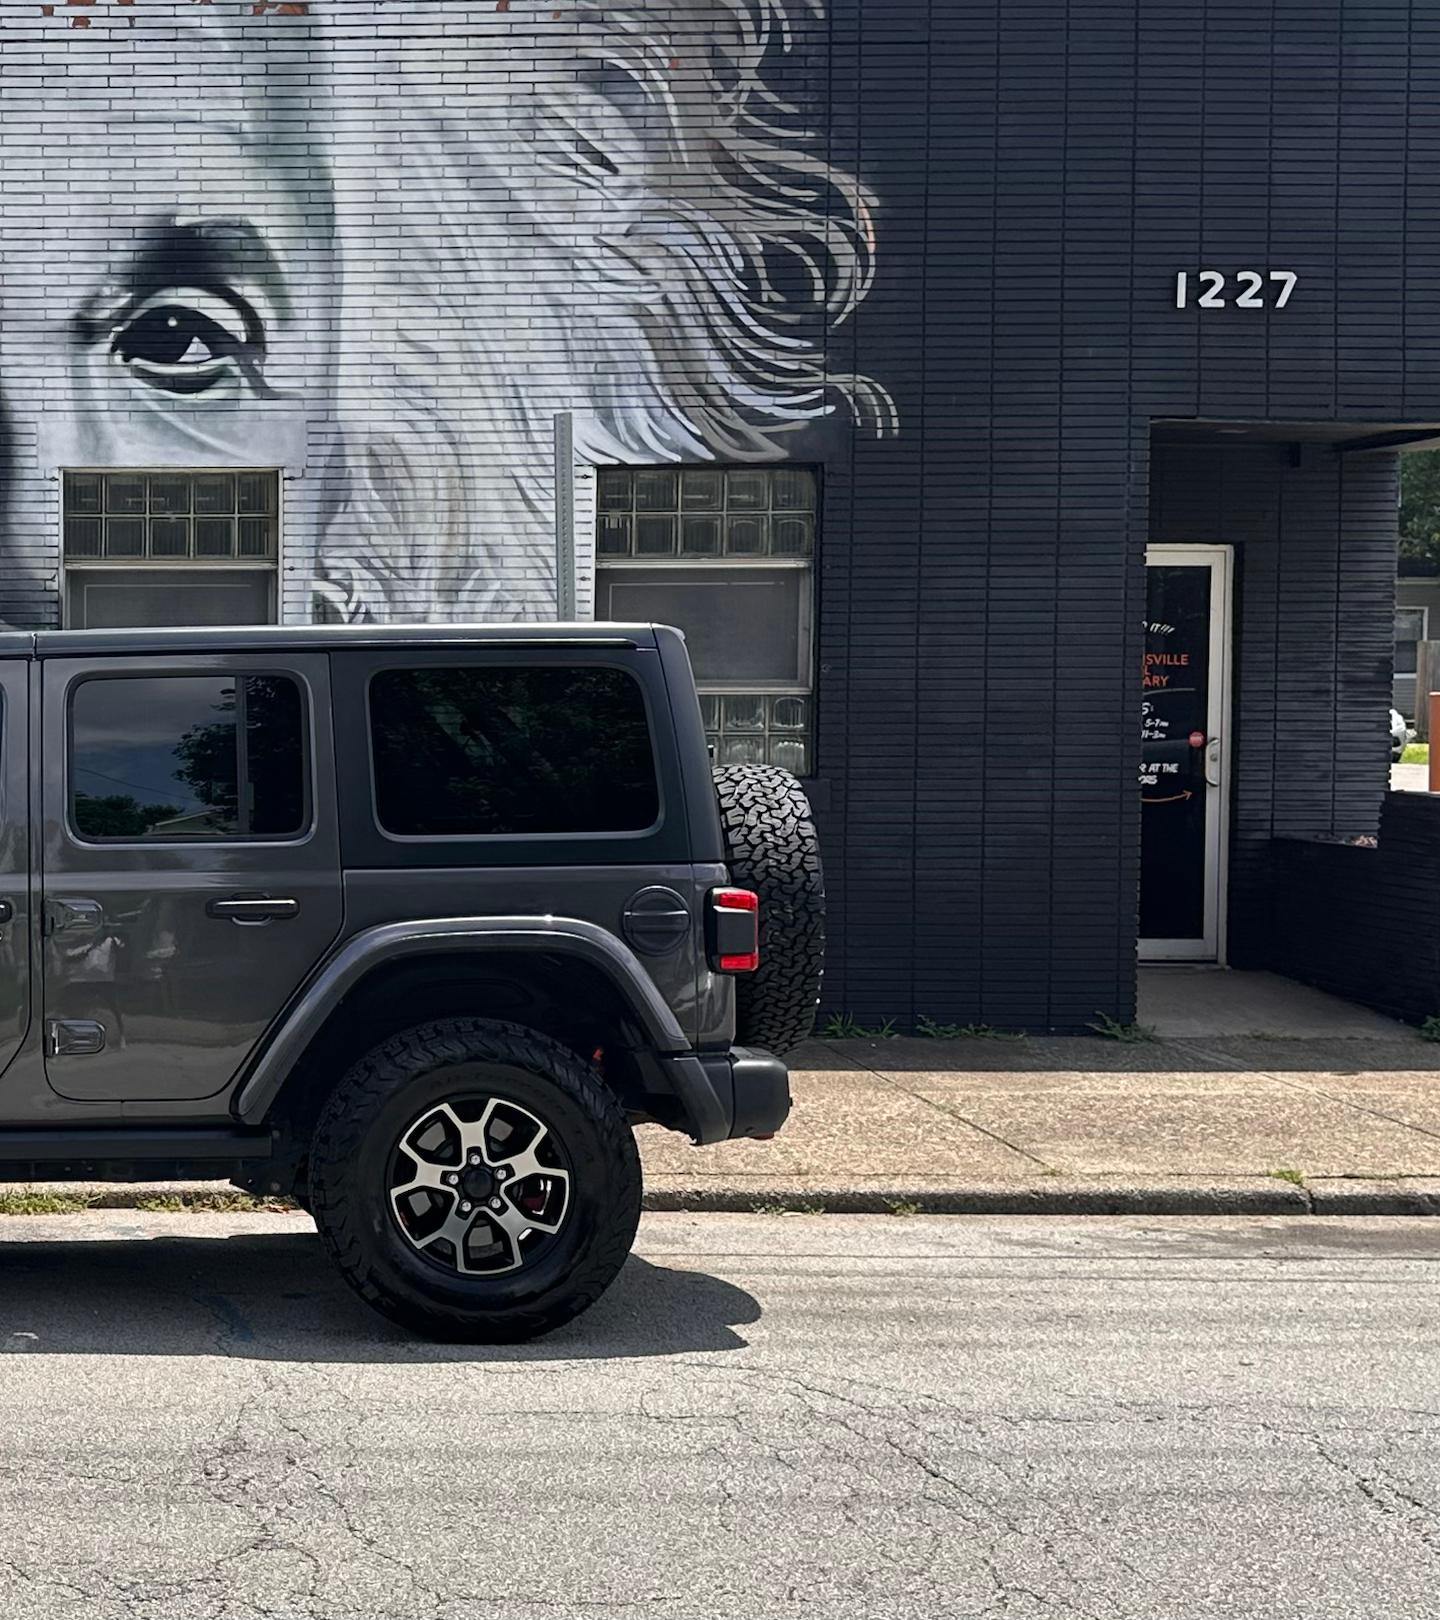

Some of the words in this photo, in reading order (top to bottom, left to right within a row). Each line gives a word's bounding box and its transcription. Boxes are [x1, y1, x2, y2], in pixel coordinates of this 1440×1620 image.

[1176, 271, 1297, 308] 1227
[1148, 763, 1161, 772] AT
[1162, 763, 1179, 773] THE
